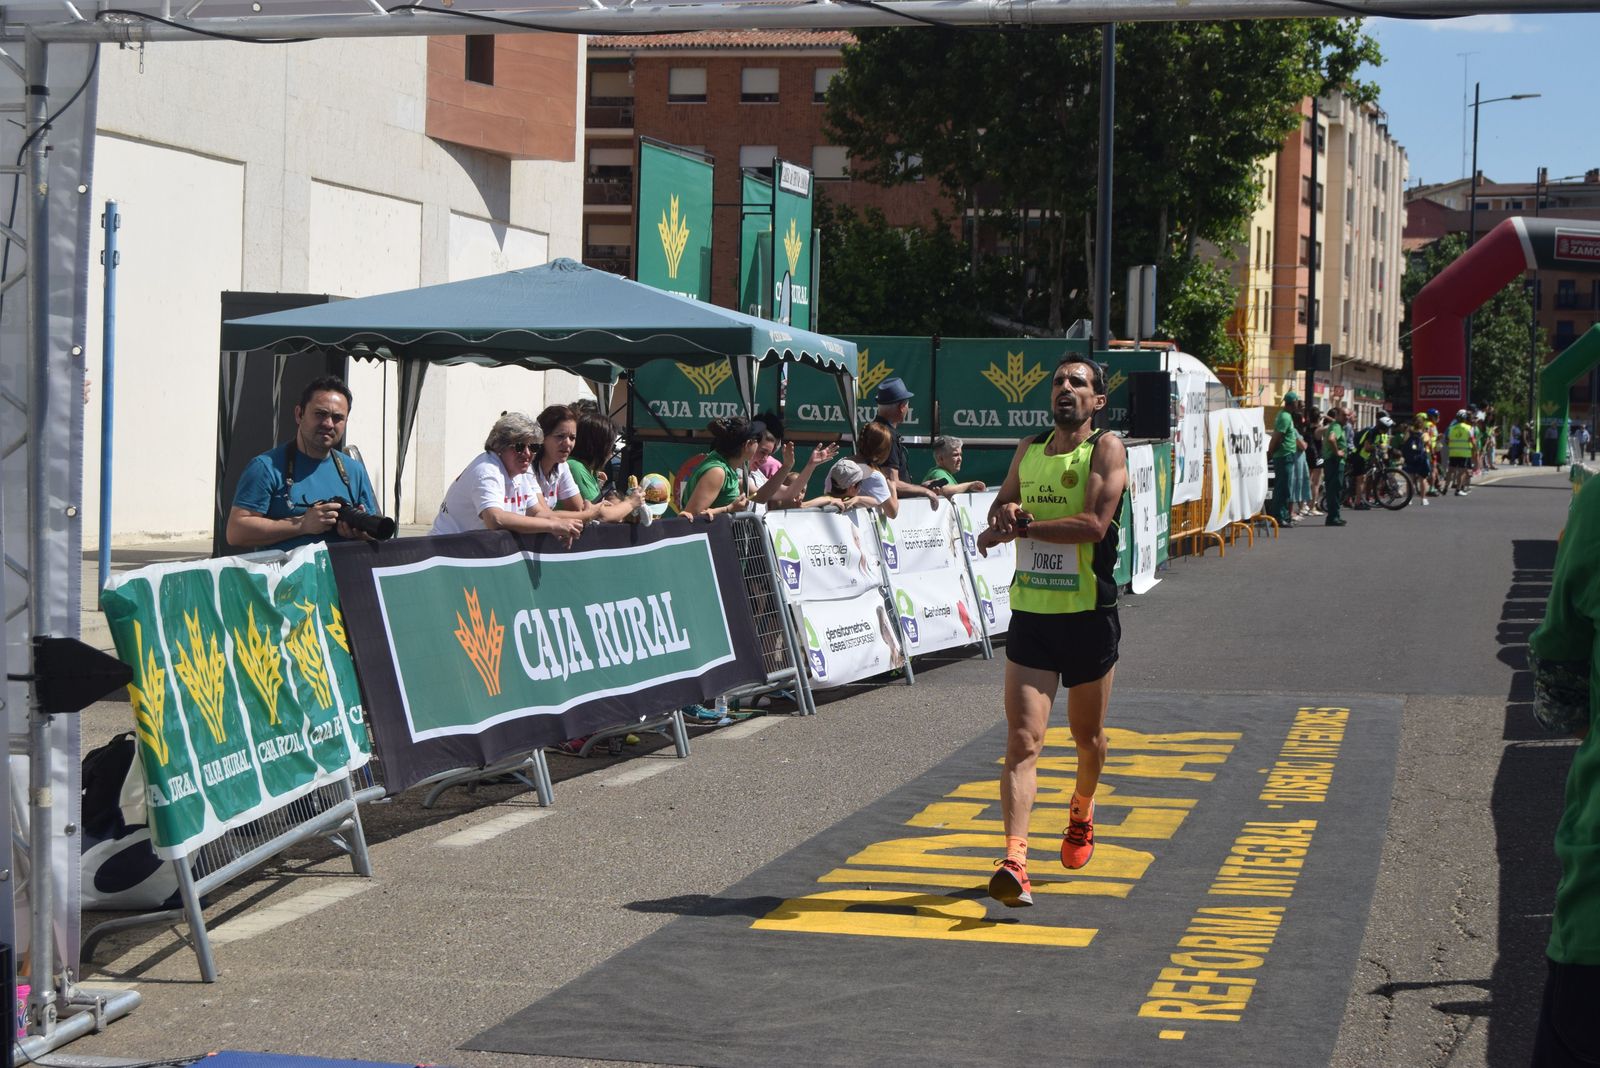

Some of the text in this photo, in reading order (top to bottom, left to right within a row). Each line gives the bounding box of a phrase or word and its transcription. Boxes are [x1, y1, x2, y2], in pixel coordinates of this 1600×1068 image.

[648, 400, 693, 418] CAJA
[797, 404, 846, 422] CAJA
[953, 409, 1001, 427] CAJA
[1039, 484, 1055, 493] C.A.
[1026, 493, 1068, 505] LA BAÑEZA
[1031, 552, 1064, 570] JORGE
[514, 591, 691, 681] CAJA RURAL
[1279, 706, 1351, 758] INTERIORES
[223, 749, 253, 780] RURAL
[1208, 819, 1318, 898] INTEGRAL
[1138, 906, 1286, 1021] REFORMA
